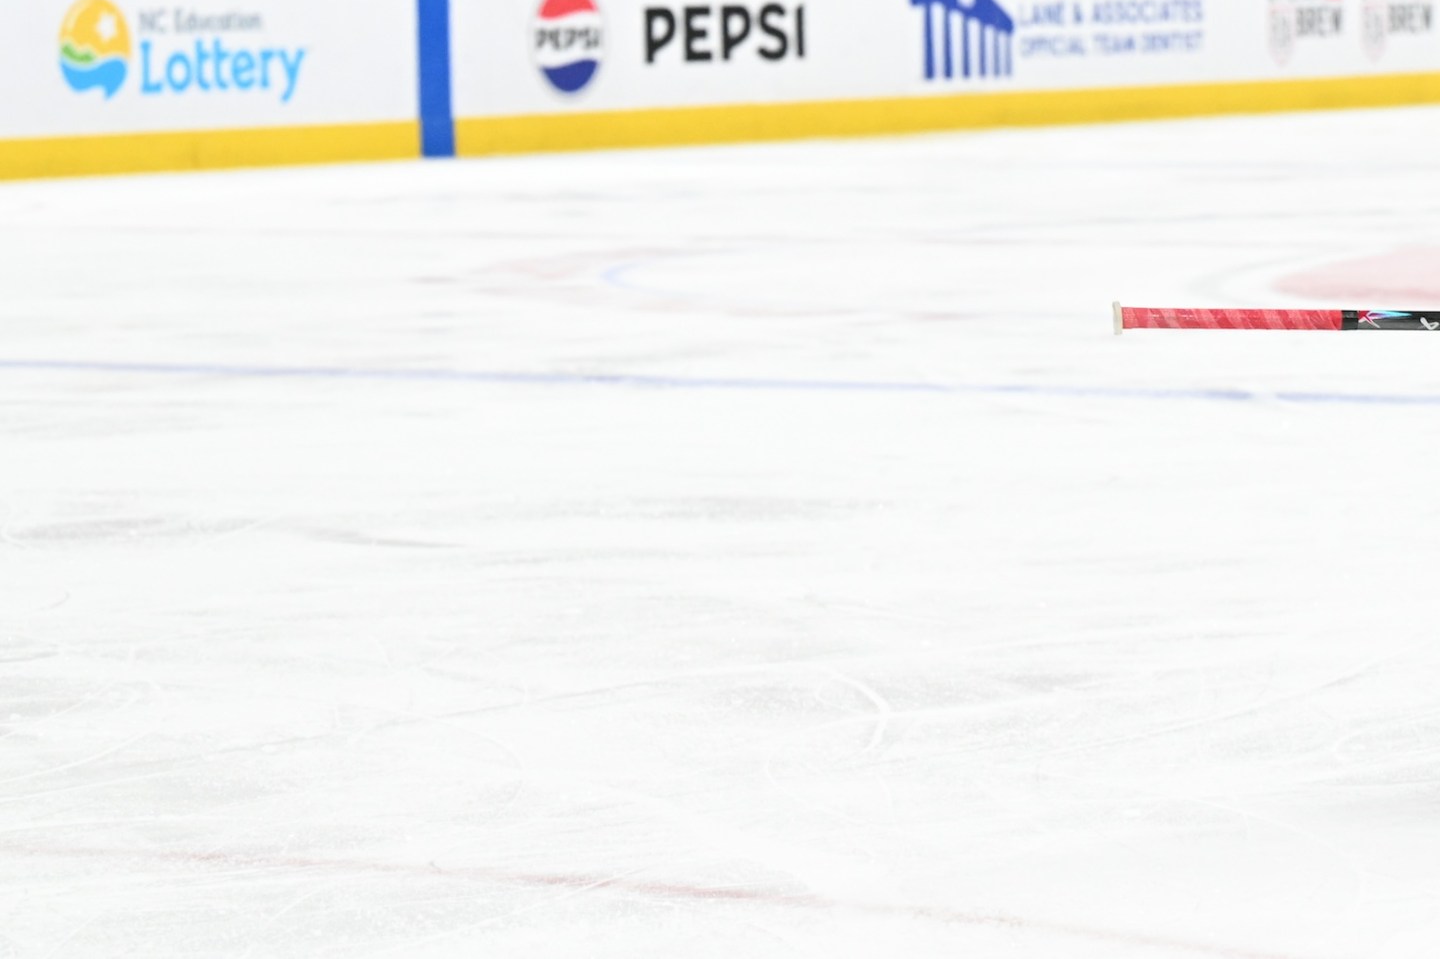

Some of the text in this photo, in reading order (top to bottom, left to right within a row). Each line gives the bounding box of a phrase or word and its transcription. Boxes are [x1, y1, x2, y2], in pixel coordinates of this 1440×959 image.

[138, 6, 263, 35] NC Education
[535, 26, 600, 51] PEPSI
[644, 2, 806, 65] PEPSI
[139, 36, 306, 105] Lottery
